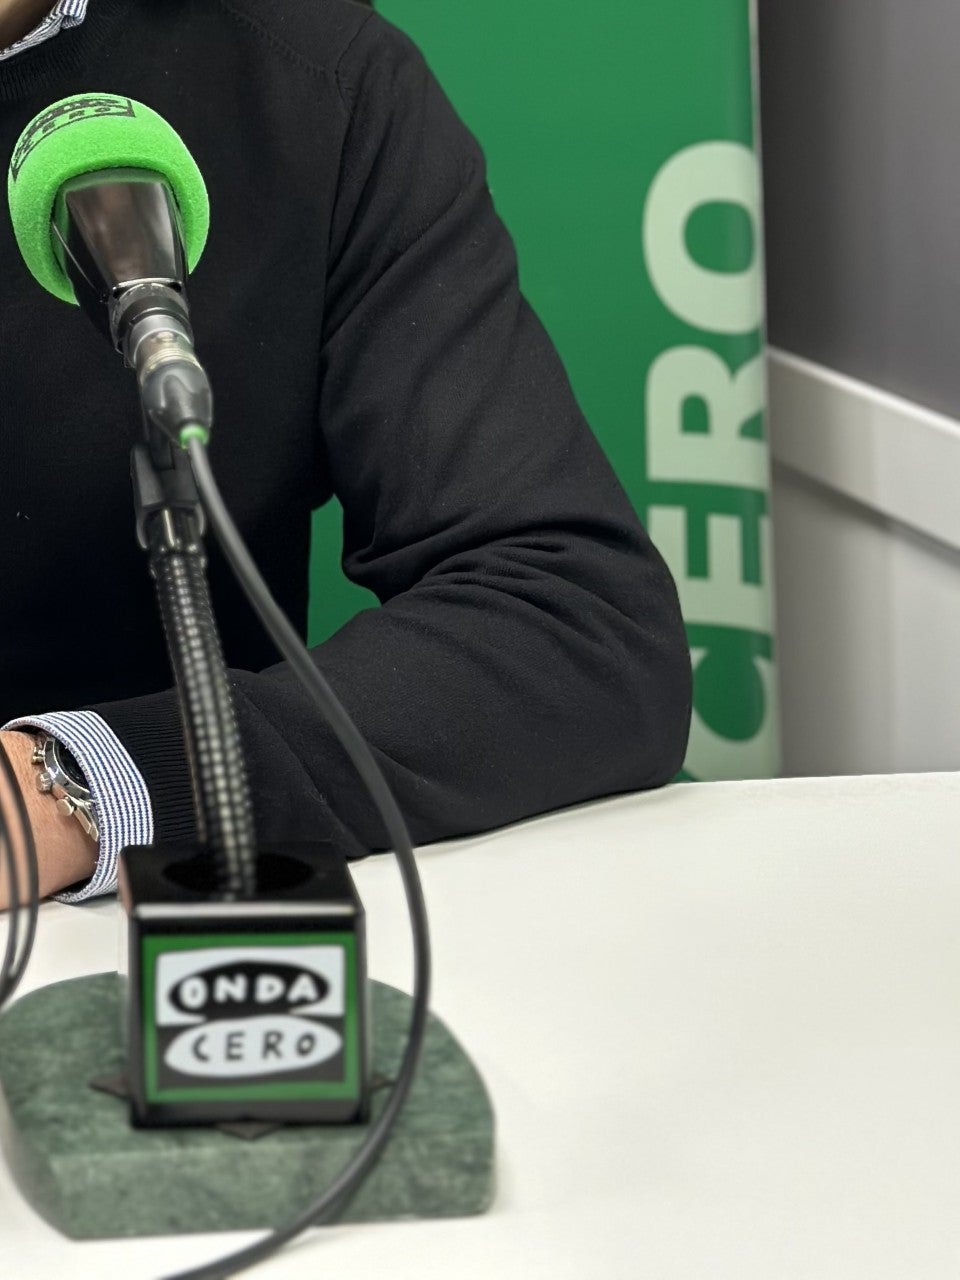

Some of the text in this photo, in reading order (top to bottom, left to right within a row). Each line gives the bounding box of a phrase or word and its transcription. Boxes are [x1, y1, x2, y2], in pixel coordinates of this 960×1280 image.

[642, 139, 782, 783] CERO
[178, 972, 321, 1009] ONDA
[191, 1031, 318, 1064] CERO
